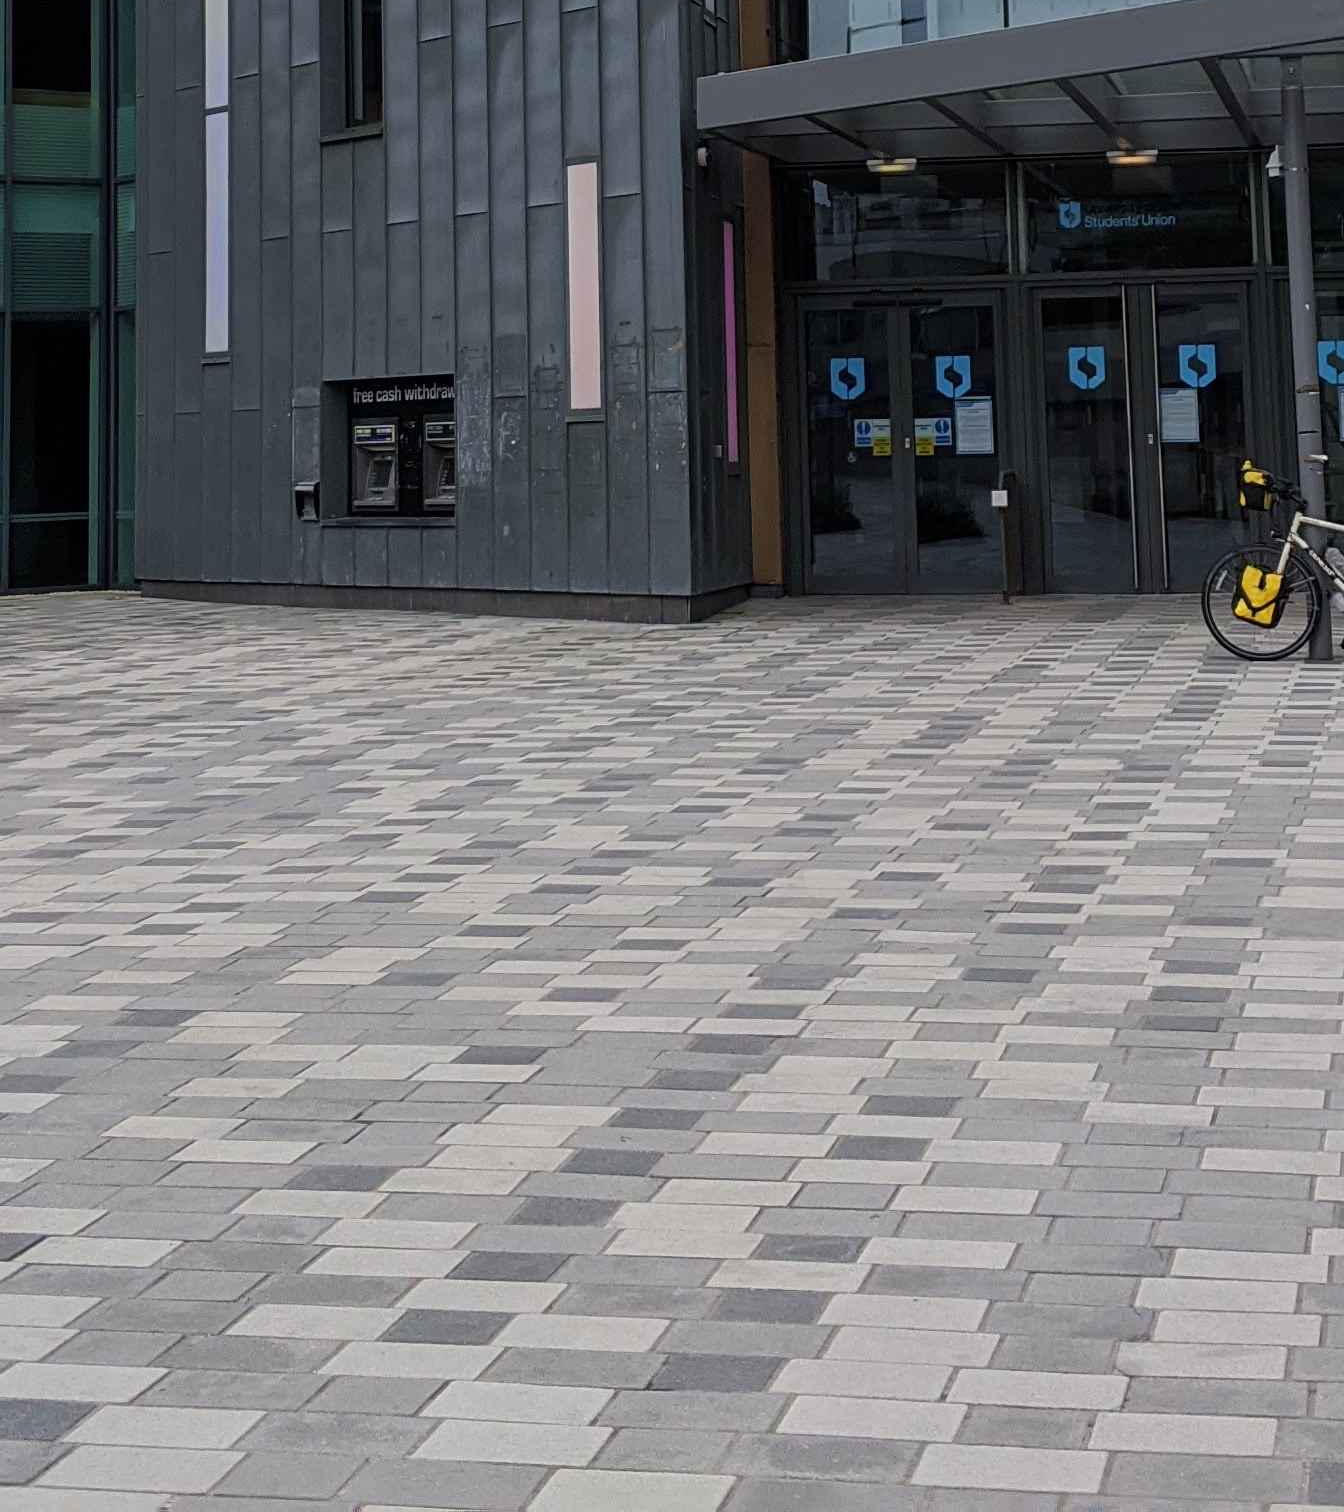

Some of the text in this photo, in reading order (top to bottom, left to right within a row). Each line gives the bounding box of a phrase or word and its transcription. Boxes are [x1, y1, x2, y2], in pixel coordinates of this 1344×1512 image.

[1142, 213, 1177, 227] Union
[353, 387, 374, 404] free
[375, 385, 402, 402] cash
